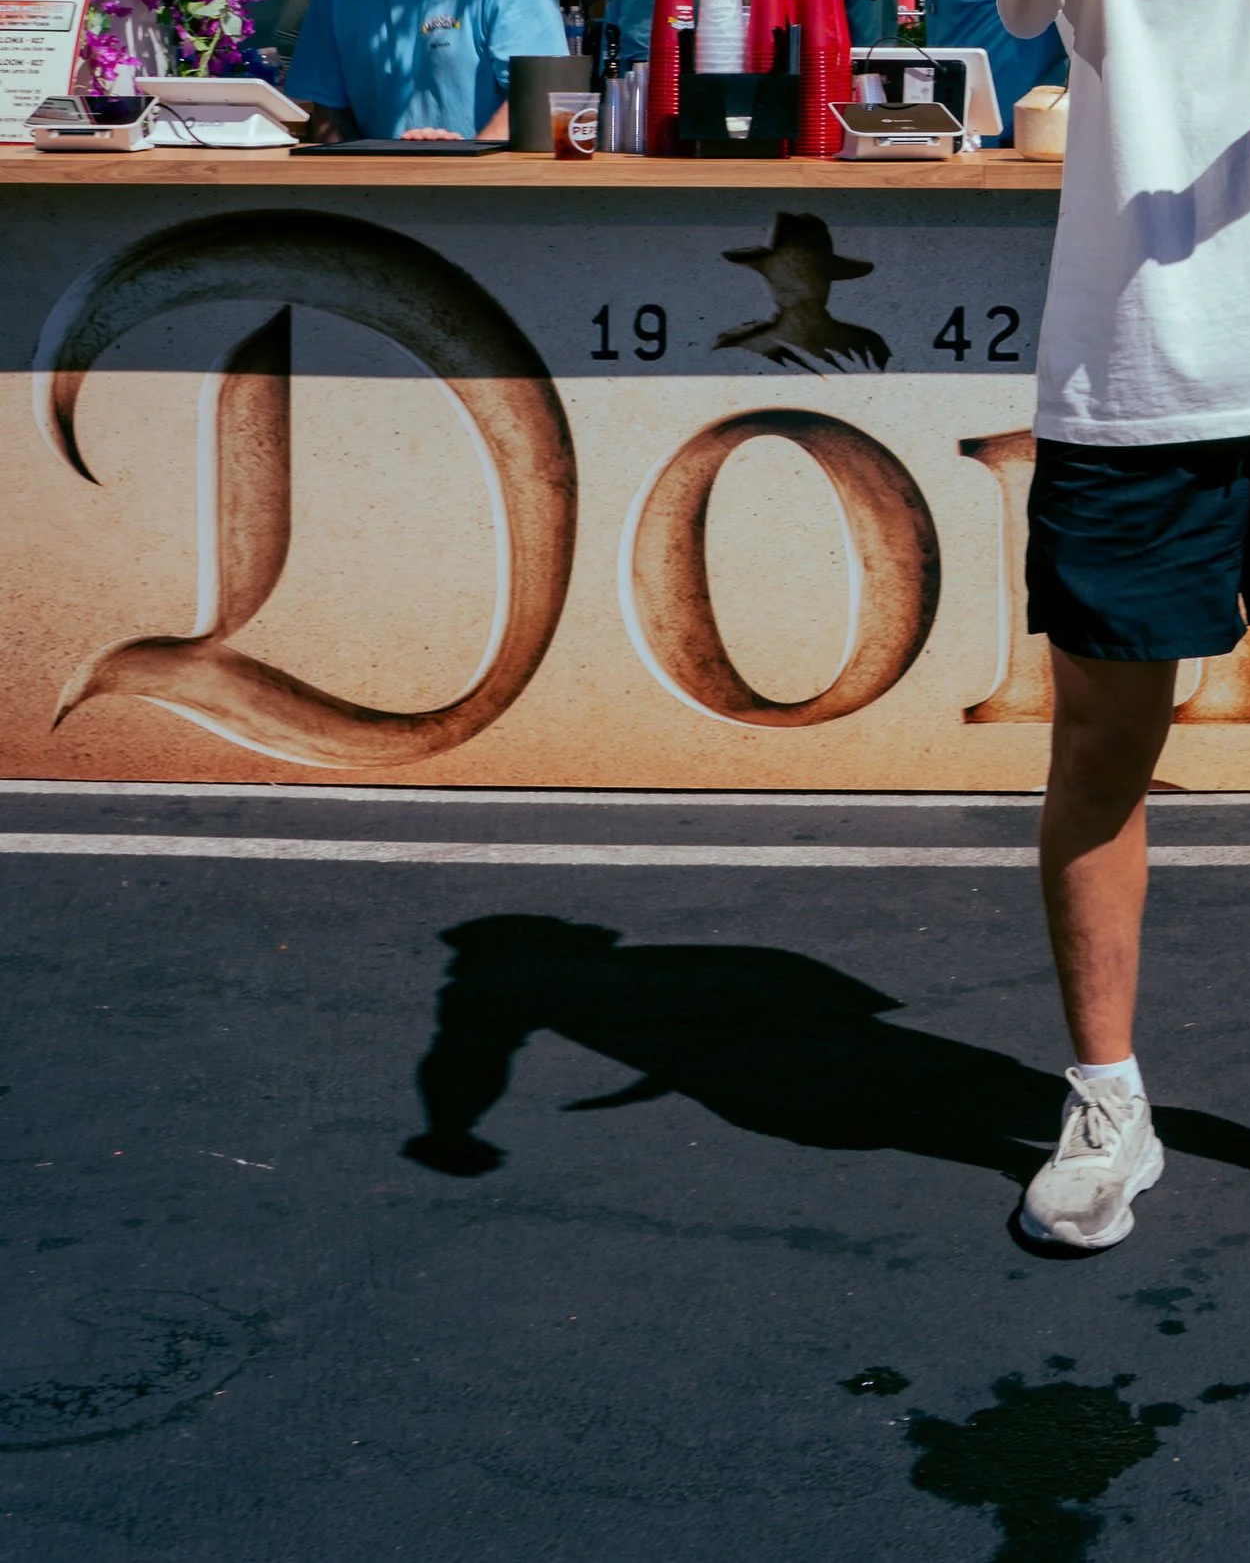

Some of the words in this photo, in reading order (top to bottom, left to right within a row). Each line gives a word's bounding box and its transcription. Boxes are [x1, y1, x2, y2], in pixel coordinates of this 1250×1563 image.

[573, 126, 598, 135] PEP
[590, 304, 667, 362] 19
[933, 304, 1020, 363] 42
